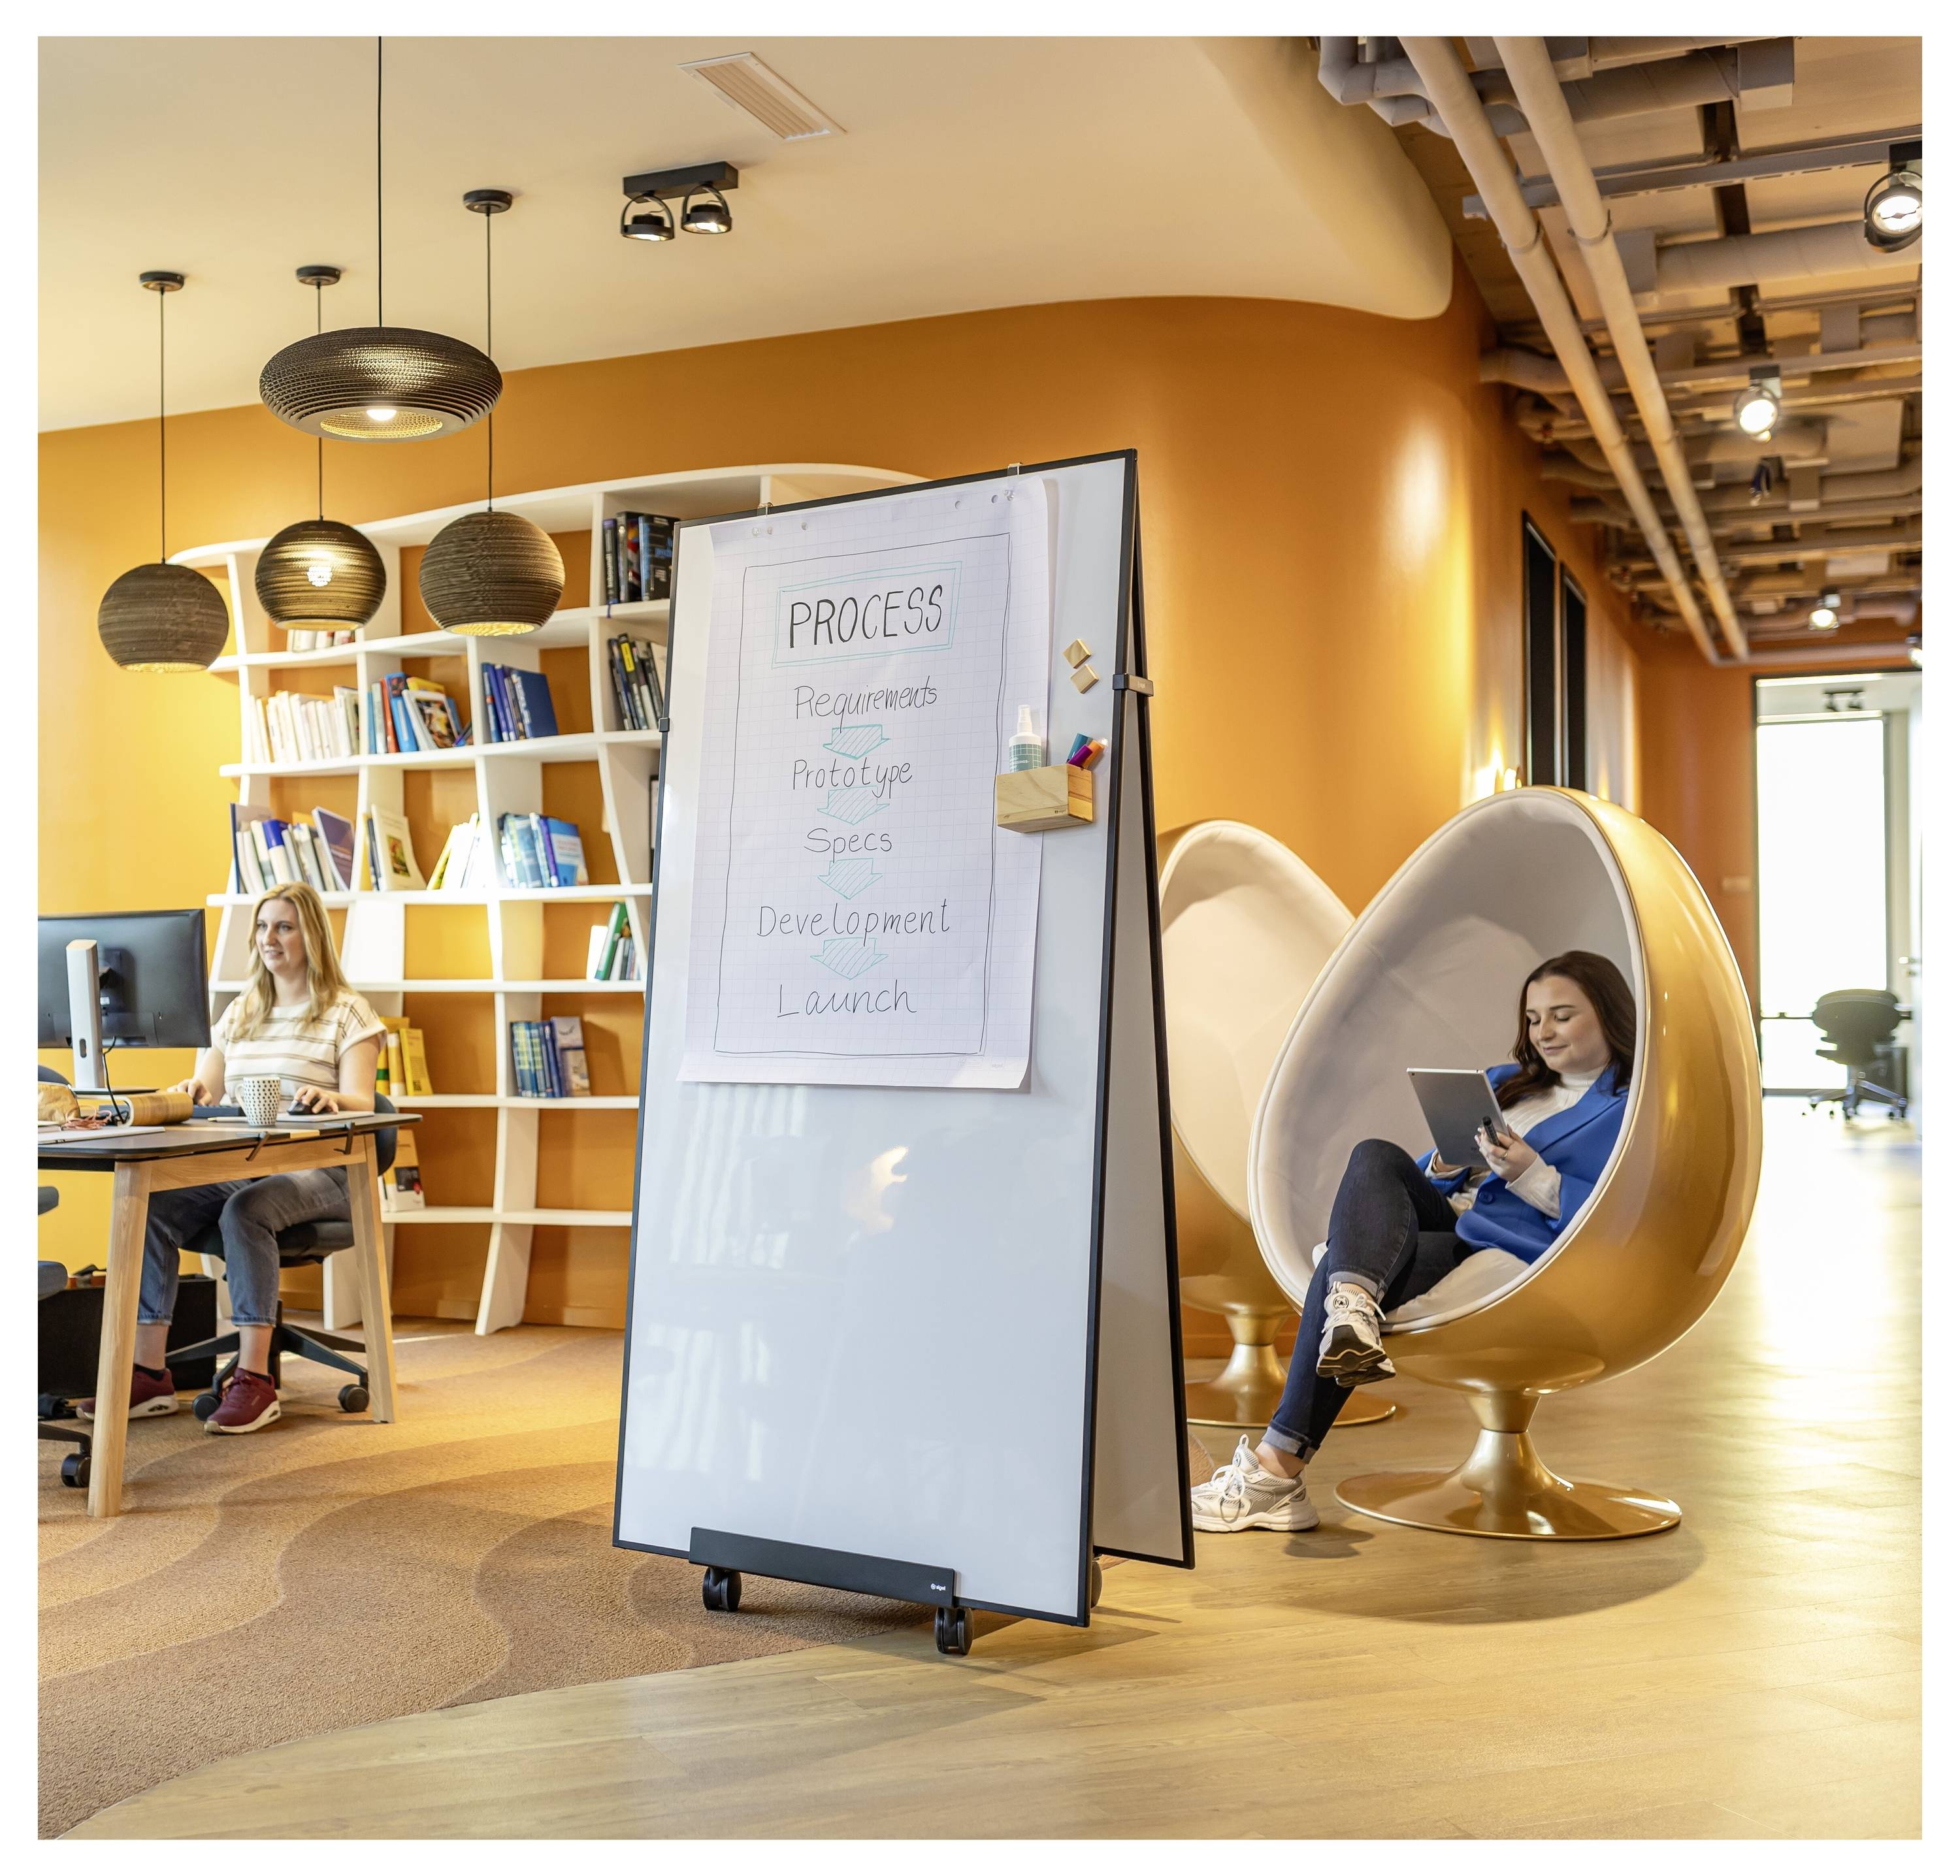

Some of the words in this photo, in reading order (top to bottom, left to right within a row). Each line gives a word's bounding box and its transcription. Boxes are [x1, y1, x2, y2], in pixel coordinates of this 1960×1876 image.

[789, 584, 943, 649] PROCESS
[794, 675, 938, 734] Requirements
[793, 757, 913, 800] Prototype
[804, 828, 892, 864] Specs
[757, 898, 950, 947] Development
[777, 979, 917, 1018] Launch
